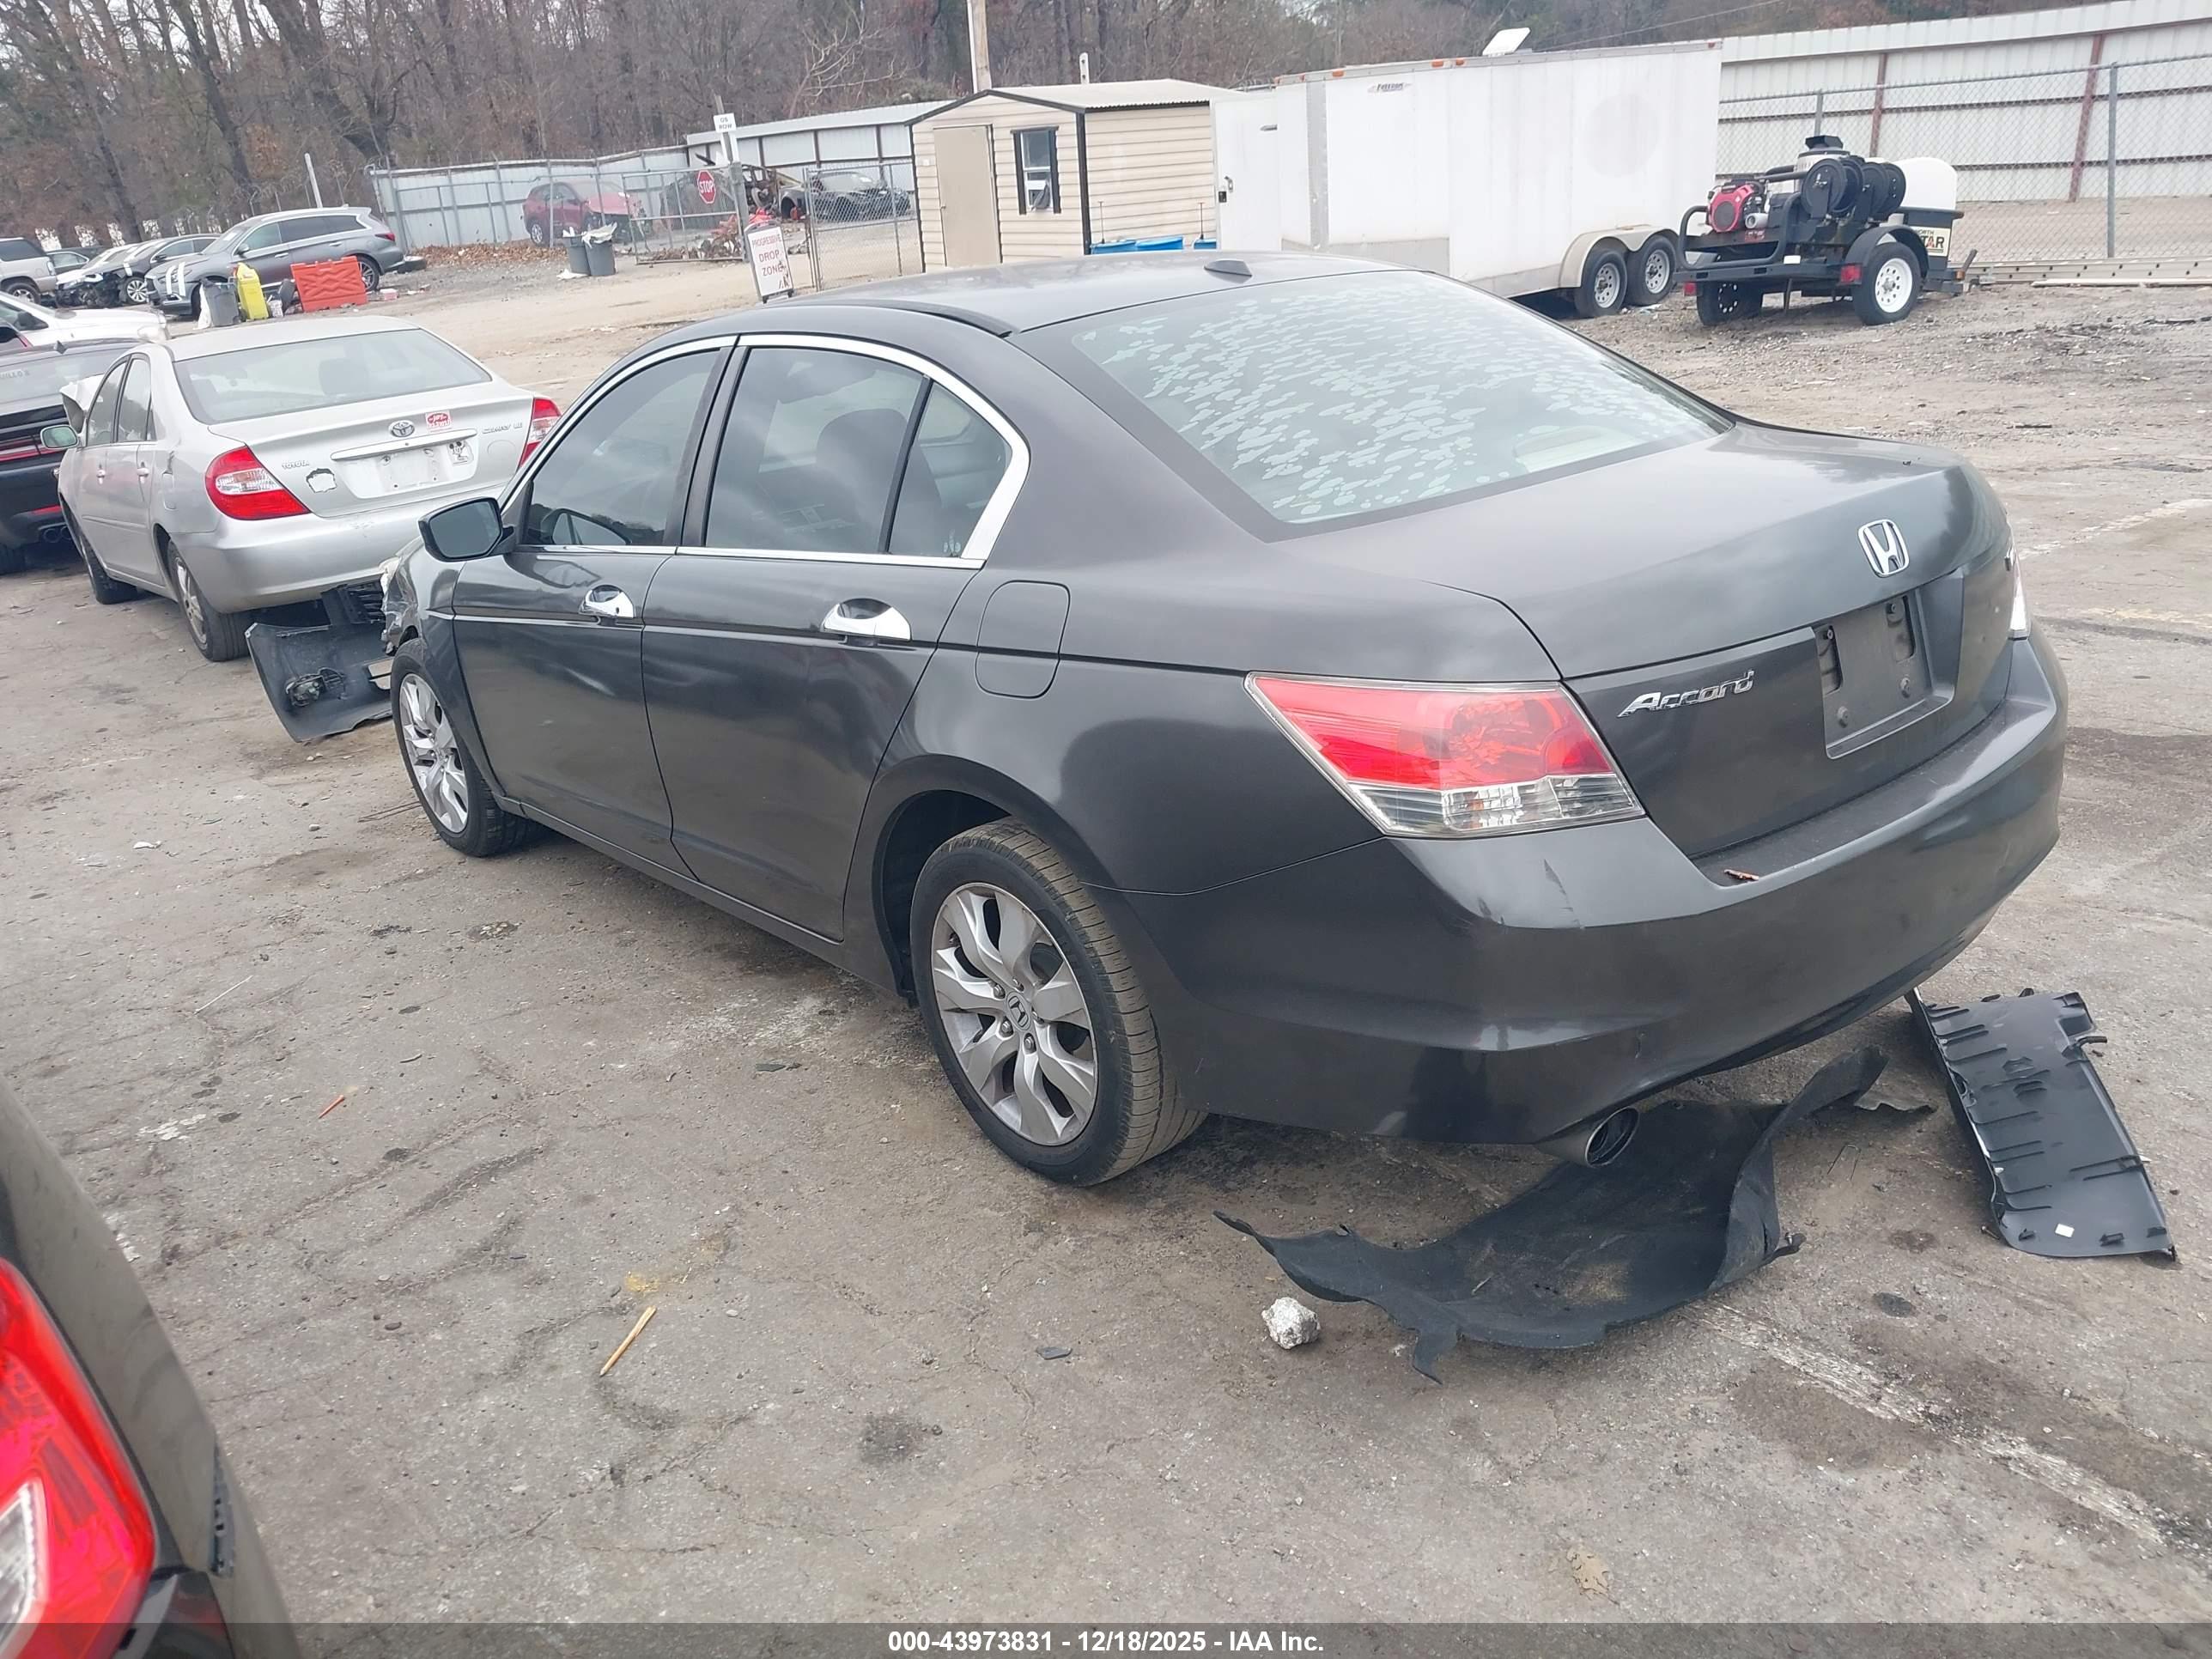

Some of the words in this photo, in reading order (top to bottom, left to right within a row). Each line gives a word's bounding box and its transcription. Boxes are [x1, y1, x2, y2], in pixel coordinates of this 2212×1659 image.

[699, 179, 714, 193] STOP
[751, 235, 781, 246] PROGRESSIVE
[1920, 235, 1945, 249] TAR
[758, 249, 780, 263] DROP
[762, 264, 783, 276] ZONE
[282, 459, 310, 470] TOYOTA
[1617, 670, 1754, 718] Accord
